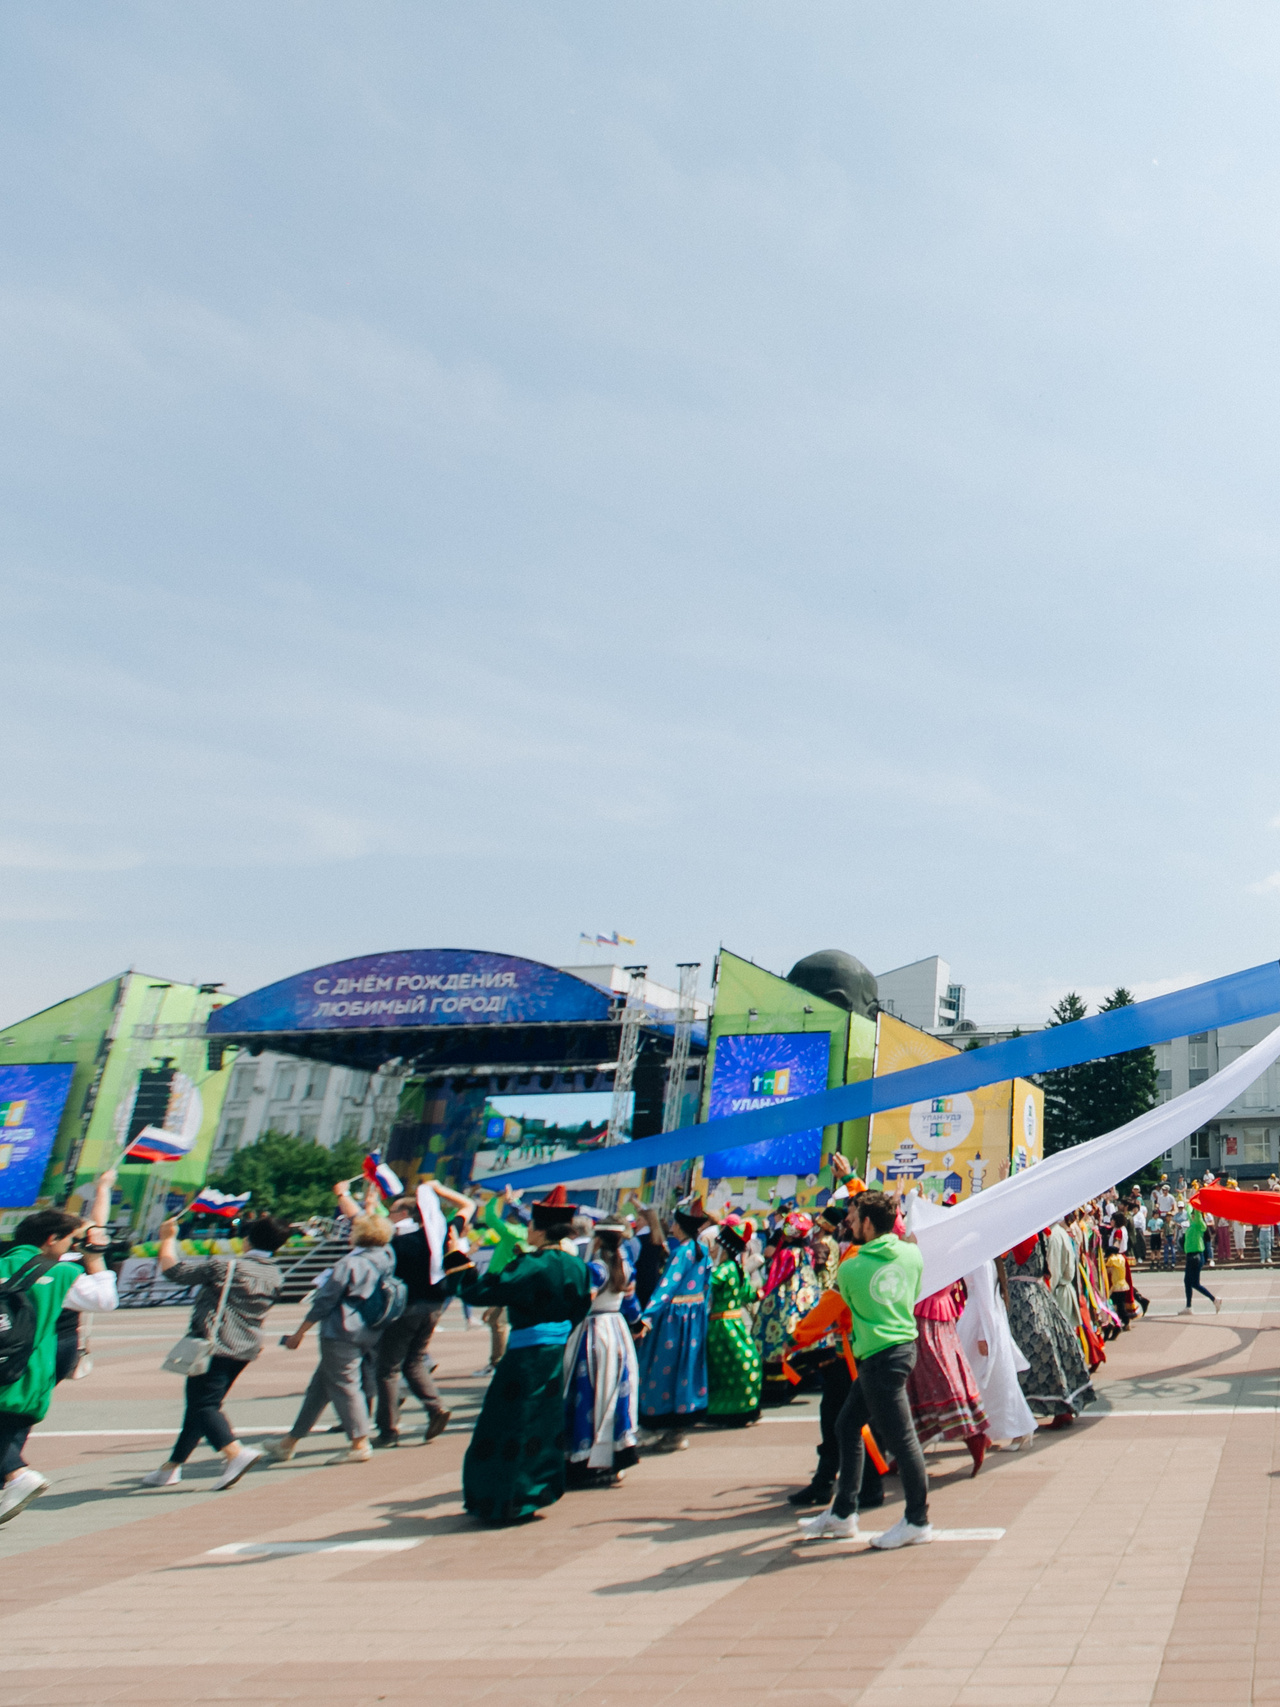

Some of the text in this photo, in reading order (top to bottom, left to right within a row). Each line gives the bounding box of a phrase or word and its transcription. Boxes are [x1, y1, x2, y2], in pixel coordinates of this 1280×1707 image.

[313, 978, 330, 995] С
[330, 974, 394, 996] ДНЁМ
[312, 995, 509, 1018] ЛЮБИМЫЙ ГОРОД!
[731, 1096, 800, 1112] УЛАН-У
[922, 1113, 962, 1122] УЛАН-УДЭ
